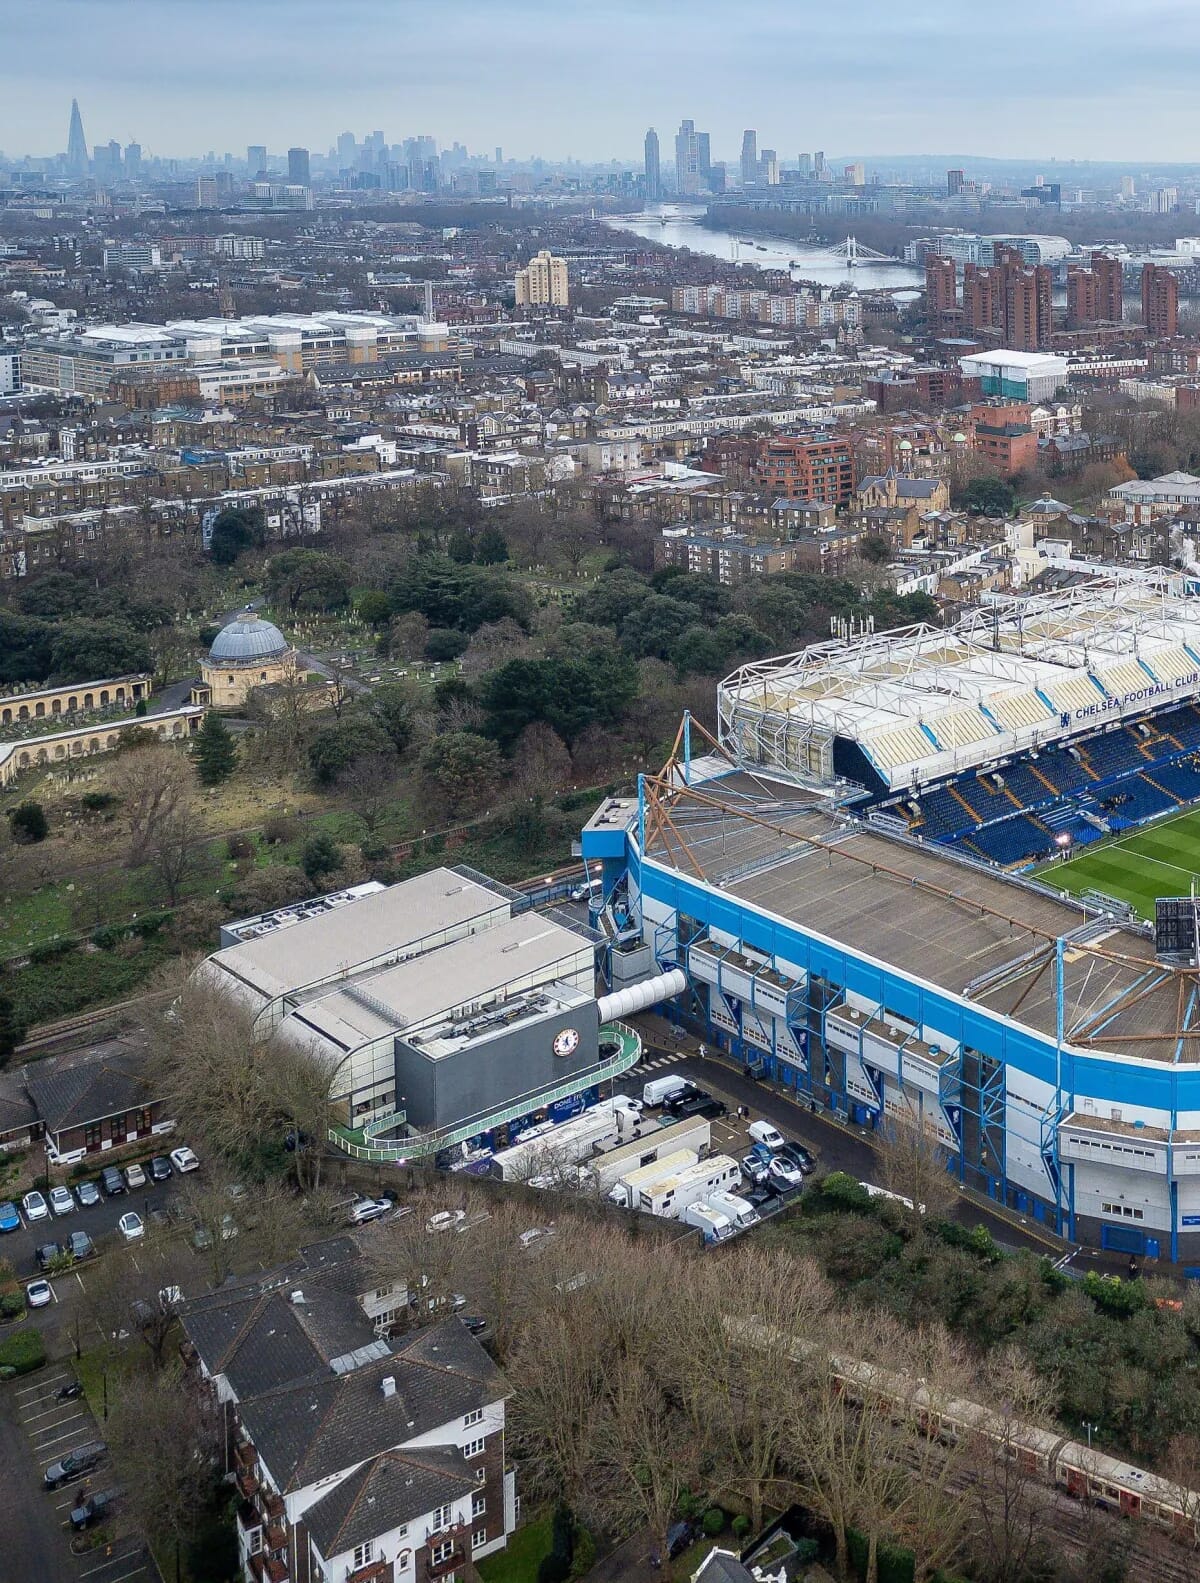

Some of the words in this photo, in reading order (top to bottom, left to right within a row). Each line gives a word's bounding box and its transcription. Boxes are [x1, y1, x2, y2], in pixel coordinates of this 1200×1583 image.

[1075, 698, 1121, 719] CHELSEA
[1124, 682, 1171, 704] FOOTBALL
[1175, 673, 1199, 688] CLUB
